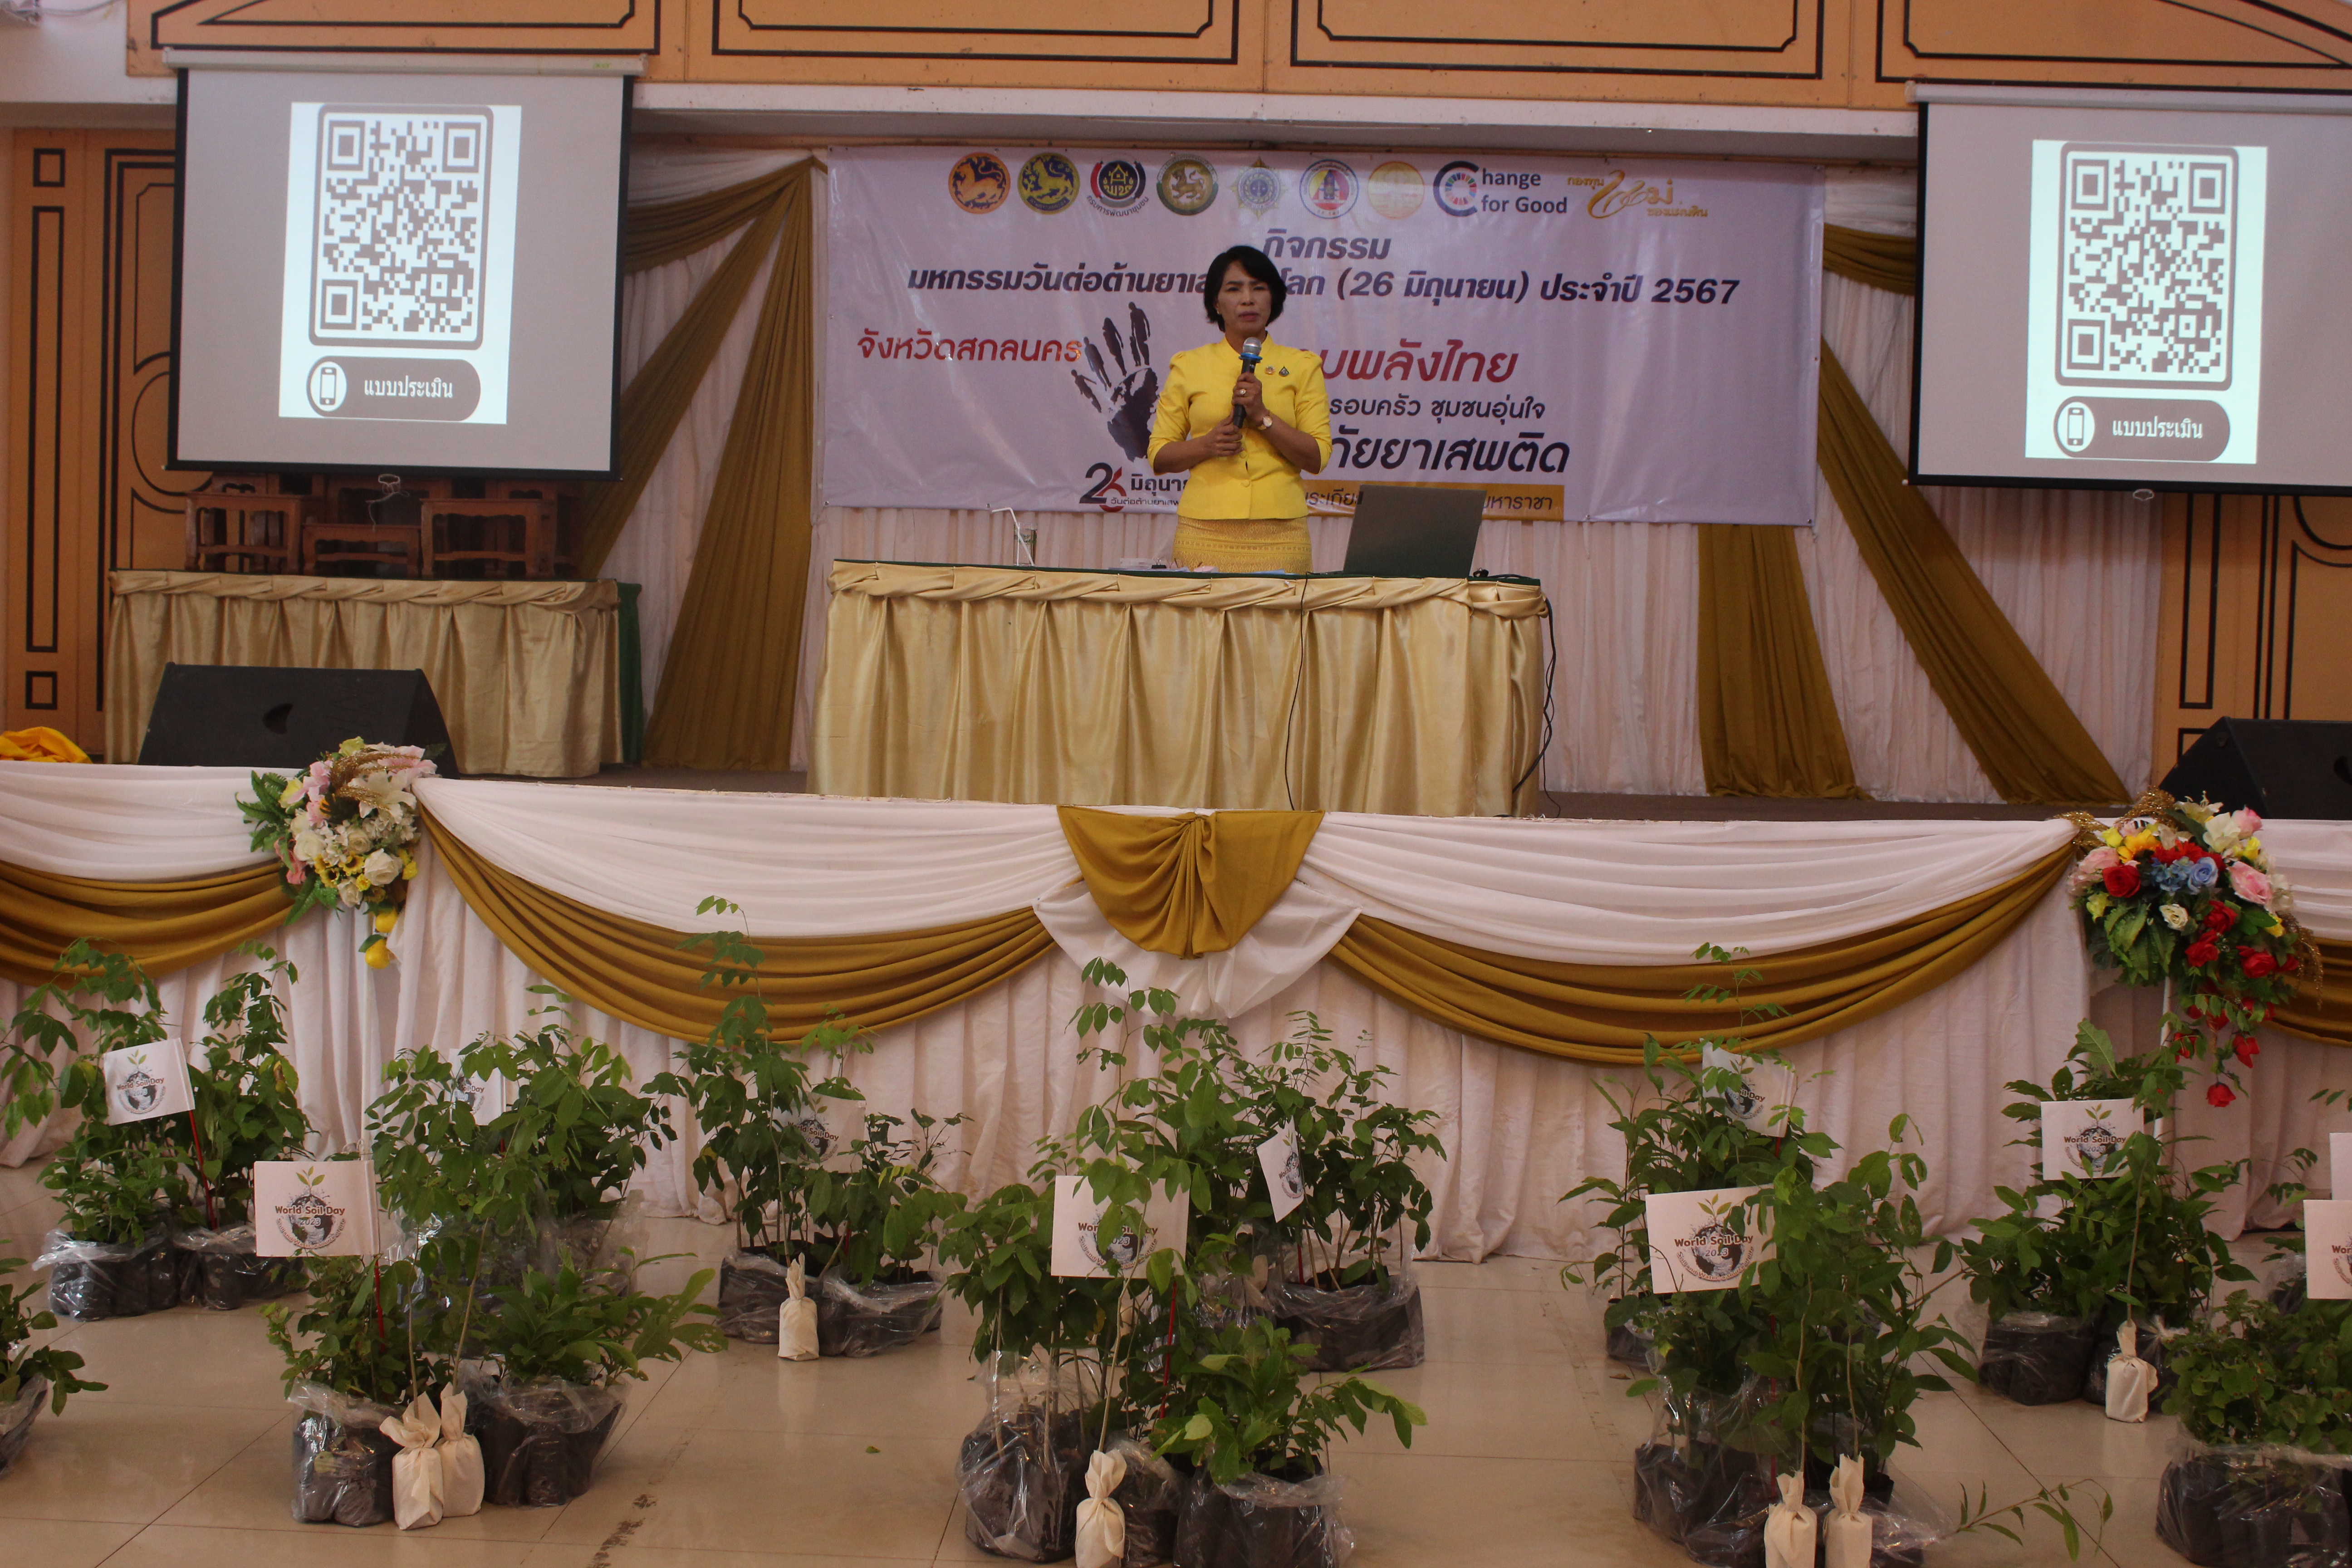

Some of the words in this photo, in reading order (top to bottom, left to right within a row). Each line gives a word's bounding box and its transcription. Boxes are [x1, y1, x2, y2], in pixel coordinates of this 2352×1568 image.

[1481, 194, 1509, 212] for
[1515, 196, 1568, 213] Good
[1262, 228, 1392, 260] กิจกรรม
[1338, 267, 1393, 300] (26
[1403, 270, 1529, 307] มิถุนายน)
[1540, 271, 1641, 303] ประจำปี
[1651, 278, 1740, 304] 2567
[857, 328, 1083, 363] จังหวัดสกลนคร
[1299, 338, 1519, 383] บพลังไทย
[364, 375, 453, 399] แบบประเมิน
[1329, 393, 1421, 416] รอบครัว
[1431, 395, 1546, 425] ชุมชนอุ่นใจ
[2112, 416, 2204, 439] แบบประเมิน
[1079, 462, 1127, 513] 26
[1111, 497, 1179, 506] วันต่อต้านยาเสพ
[1305, 488, 1358, 505] ระเกีย
[117, 1081, 134, 1091] World
[136, 1078, 149, 1088] Soil
[151, 1077, 165, 1085] Day
[1749, 1092, 1766, 1102] Day
[809, 1127, 823, 1137] Soil
[824, 1132, 839, 1142] Day
[1279, 1167, 1292, 1180] World
[275, 1205, 302, 1215] World
[305, 1206, 323, 1215] Soil
[326, 1206, 345, 1215] Day
[1078, 1222, 1098, 1232] Wor
[1674, 1237, 1706, 1247] World
[1710, 1235, 1731, 1245] Soil
[2331, 1245, 2352, 1254] Wor
[1686, 1264, 1697, 1275] and
